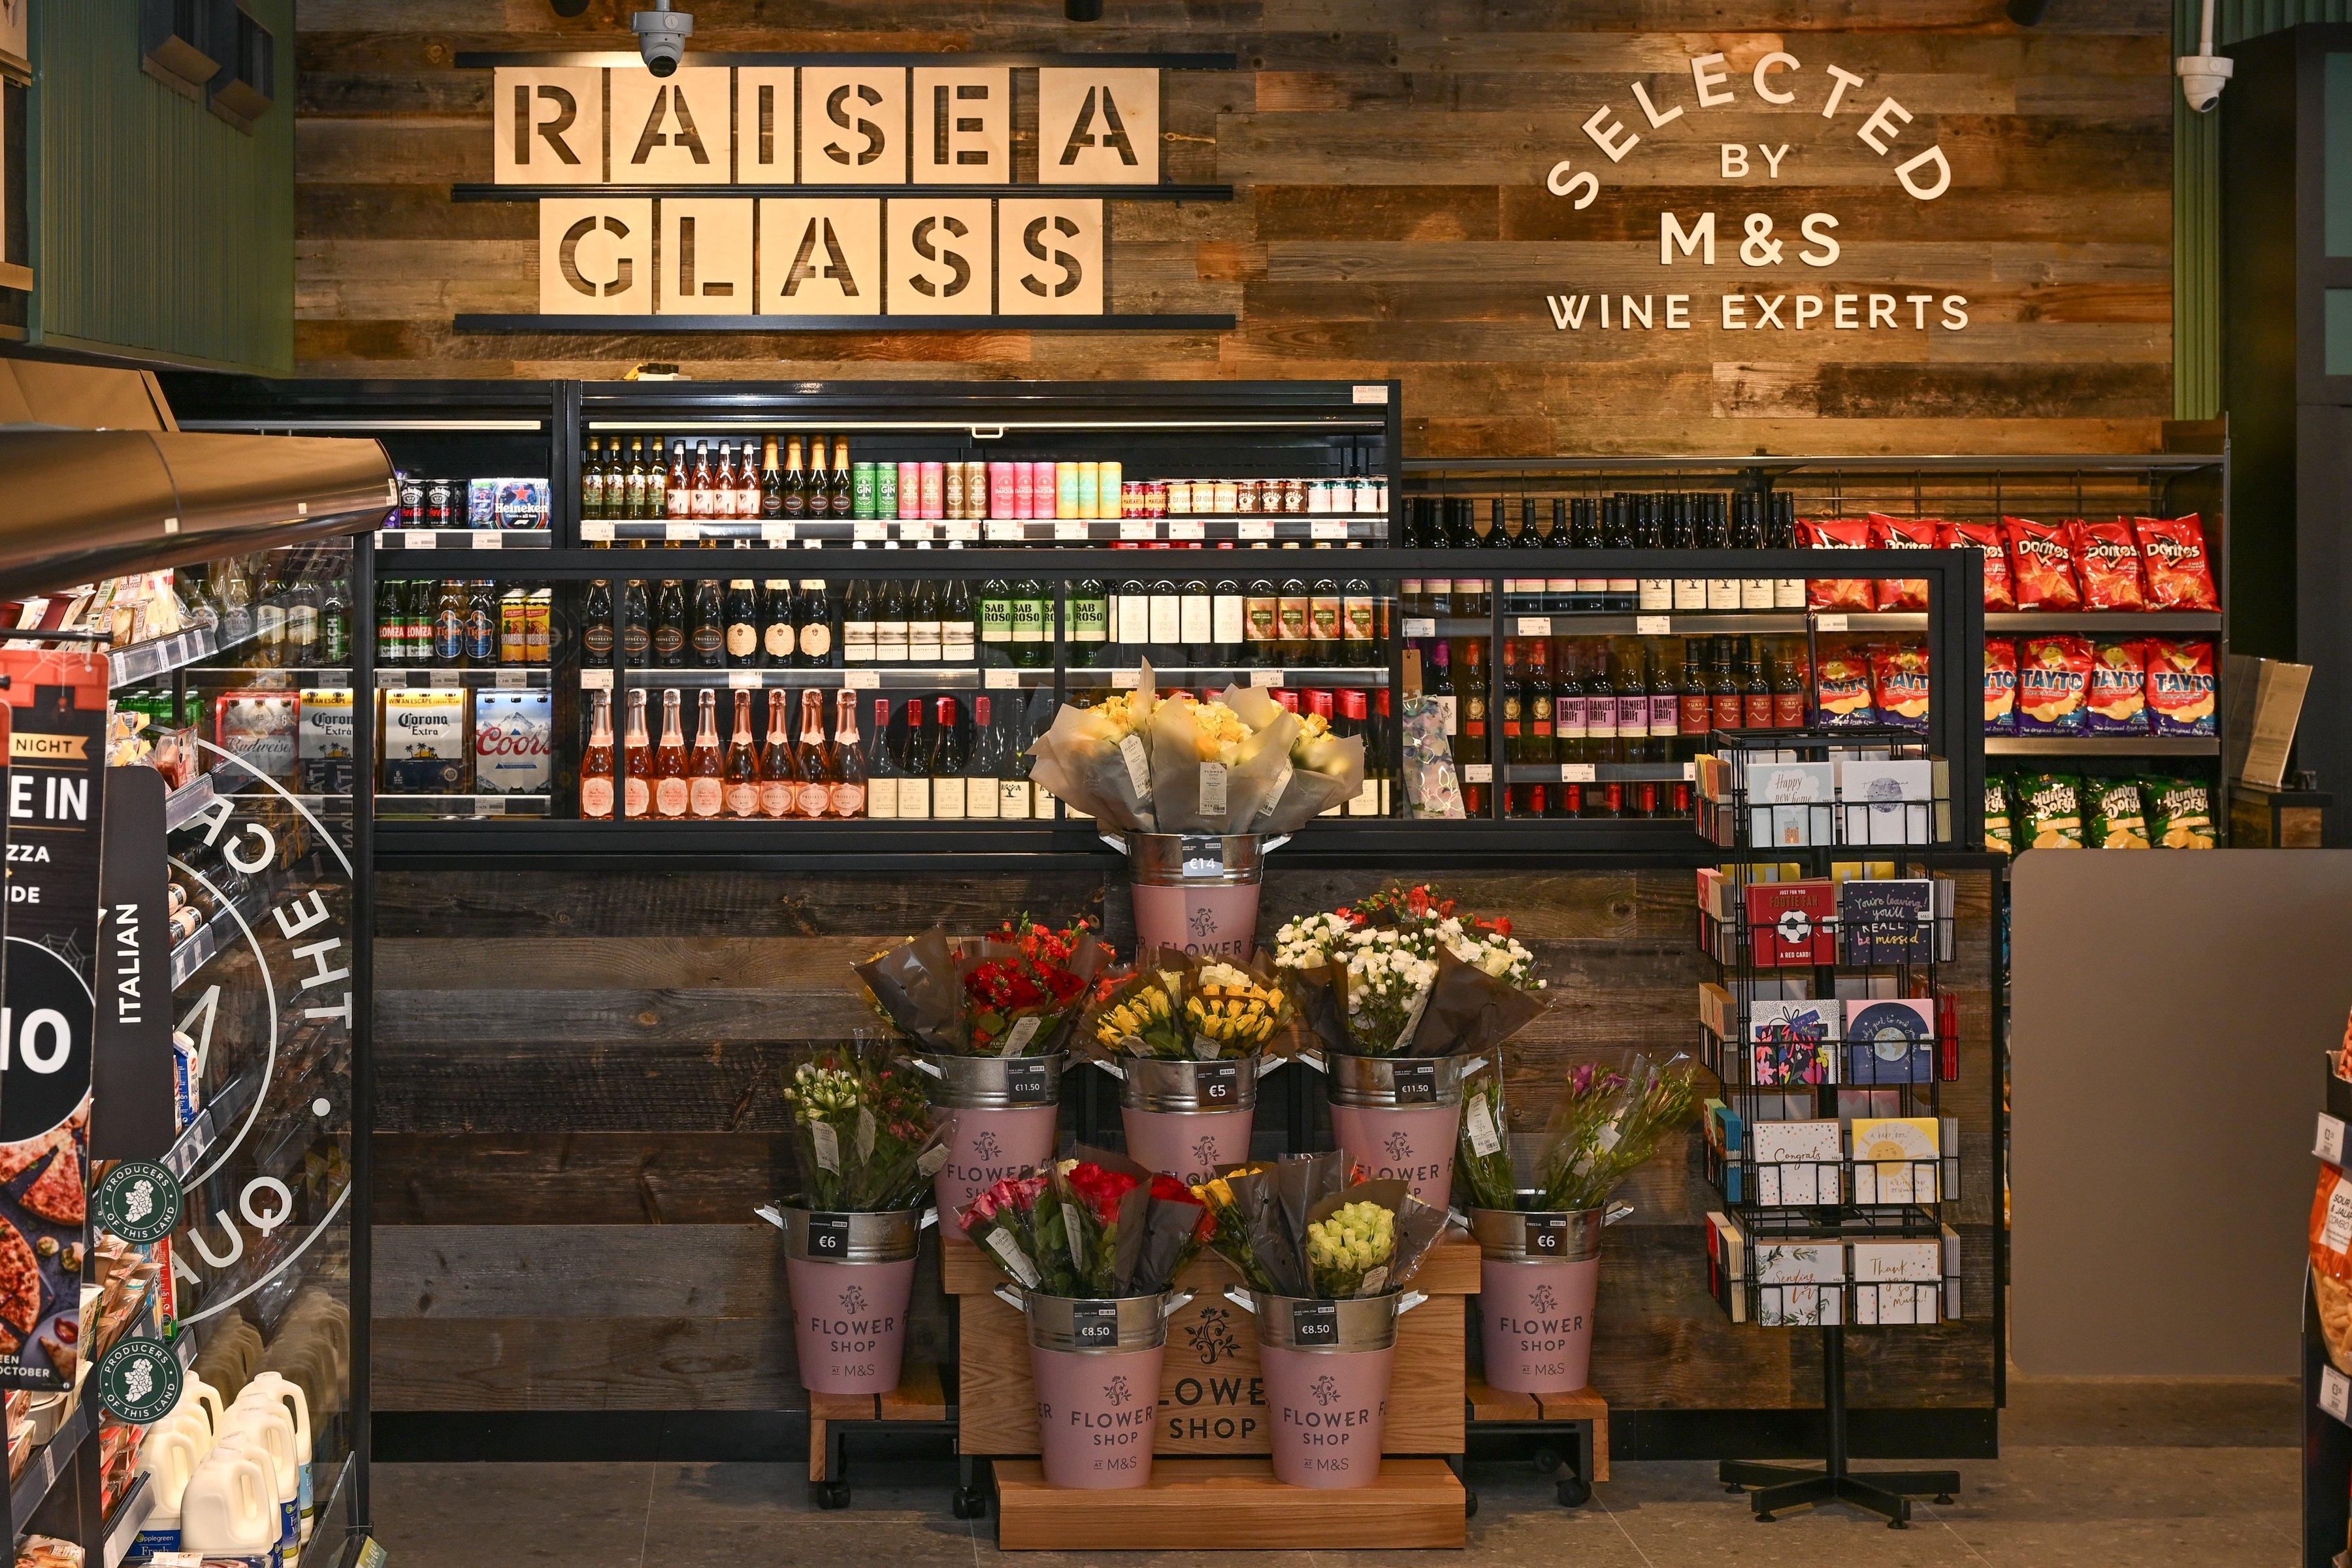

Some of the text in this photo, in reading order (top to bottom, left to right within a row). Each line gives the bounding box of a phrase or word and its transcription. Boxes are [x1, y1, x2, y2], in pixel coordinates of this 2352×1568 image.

[514, 84, 1139, 165] RAISE A
[1546, 52, 1952, 210] SELECTED
[1721, 143, 1790, 178] BY
[1660, 211, 1841, 267] M&S
[559, 215, 1083, 297] GLASS
[1546, 293, 1969, 330] WINE EXPERTS
[857, 485, 872, 494] GIN
[881, 485, 896, 494] GIN
[494, 502, 549, 514] Heineken
[2018, 540, 2069, 559] Doritos
[2087, 543, 2142, 558] Doritos
[2146, 543, 2200, 558] Doritos
[985, 603, 1004, 613] SAB
[1013, 603, 1032, 613] SAB
[1076, 603, 1095, 613] SAB
[985, 612, 1011, 622] ROSO
[1013, 612, 1039, 622] ROSO
[1076, 612, 1103, 622] ROSO
[436, 628, 461, 640] Tiger
[466, 628, 492, 640] Tiger
[1882, 671, 1929, 690] TAYT
[2021, 668, 2085, 691] TAYTO
[2154, 672, 2215, 693] TAYTO
[1560, 700, 1585, 711] DANIEL'S
[1589, 700, 1614, 711] DANIEL'S
[1620, 700, 1646, 710] DANIEL'S
[312, 711, 353, 728] Coron
[398, 712, 449, 729] Corona
[1560, 711, 1577, 723] DRIFT
[1589, 711, 1607, 723] DRIFT
[1621, 710, 1638, 723] DRIFT
[1654, 709, 1671, 721] DRIFT
[16, 738, 73, 754] NIGHT
[1775, 774, 1803, 791] Happy
[45, 777, 88, 821] IN
[1775, 792, 1813, 804] new home
[2033, 786, 2075, 806] Hunky
[2102, 786, 2138, 805] Hunky
[2164, 787, 2207, 806] Hunky
[5, 844, 51, 863] ZZA
[1189, 858, 1216, 870] €14
[1769, 895, 1818, 907] FOOTIE FAN
[1855, 893, 1928, 913] You're leaving!
[1872, 906, 1905, 921] you'll
[1857, 931, 1871, 946] be
[116, 904, 142, 1024] ITALIAN
[1801, 1026, 1818, 1036] Mum
[1209, 1085, 1226, 1098] €5
[1402, 1084, 1429, 1093] €11.50
[1774, 1146, 1822, 1171] Congrats
[105, 1165, 170, 1193] PRODUCERS
[2333, 1194, 2350, 1205] SOUR
[106, 1205, 175, 1239] OF THIS LAND
[819, 1235, 836, 1249] €6
[995, 1232, 1009, 1245] FLOWER
[1537, 1235, 1556, 1247] €6
[1870, 1257, 1908, 1276] Thank
[1772, 1269, 1816, 1290] Sending
[1898, 1284, 1910, 1297] so
[811, 1316, 894, 1335] FLOWER
[1082, 1327, 1110, 1336] €8.50
[1302, 1324, 1330, 1334] €8.50
[1500, 1315, 1583, 1335] FLOWER
[831, 1341, 875, 1352] SHOP
[1521, 1339, 1566, 1352] SHOP
[104, 1343, 169, 1373] PRODUCERS
[845, 1364, 875, 1377] M&S
[1535, 1362, 1565, 1376] M&S
[106, 1382, 176, 1418] OF THIS LAND
[1071, 1405, 1153, 1429] FLOWER
[1283, 1407, 1369, 1428] FLOWER
[1169, 1418, 1256, 1439] SHOP
[1093, 1431, 1139, 1446] SHOP
[1303, 1433, 1350, 1446] SHOP
[1107, 1456, 1137, 1471] M&S
[1317, 1458, 1349, 1471] M&S
